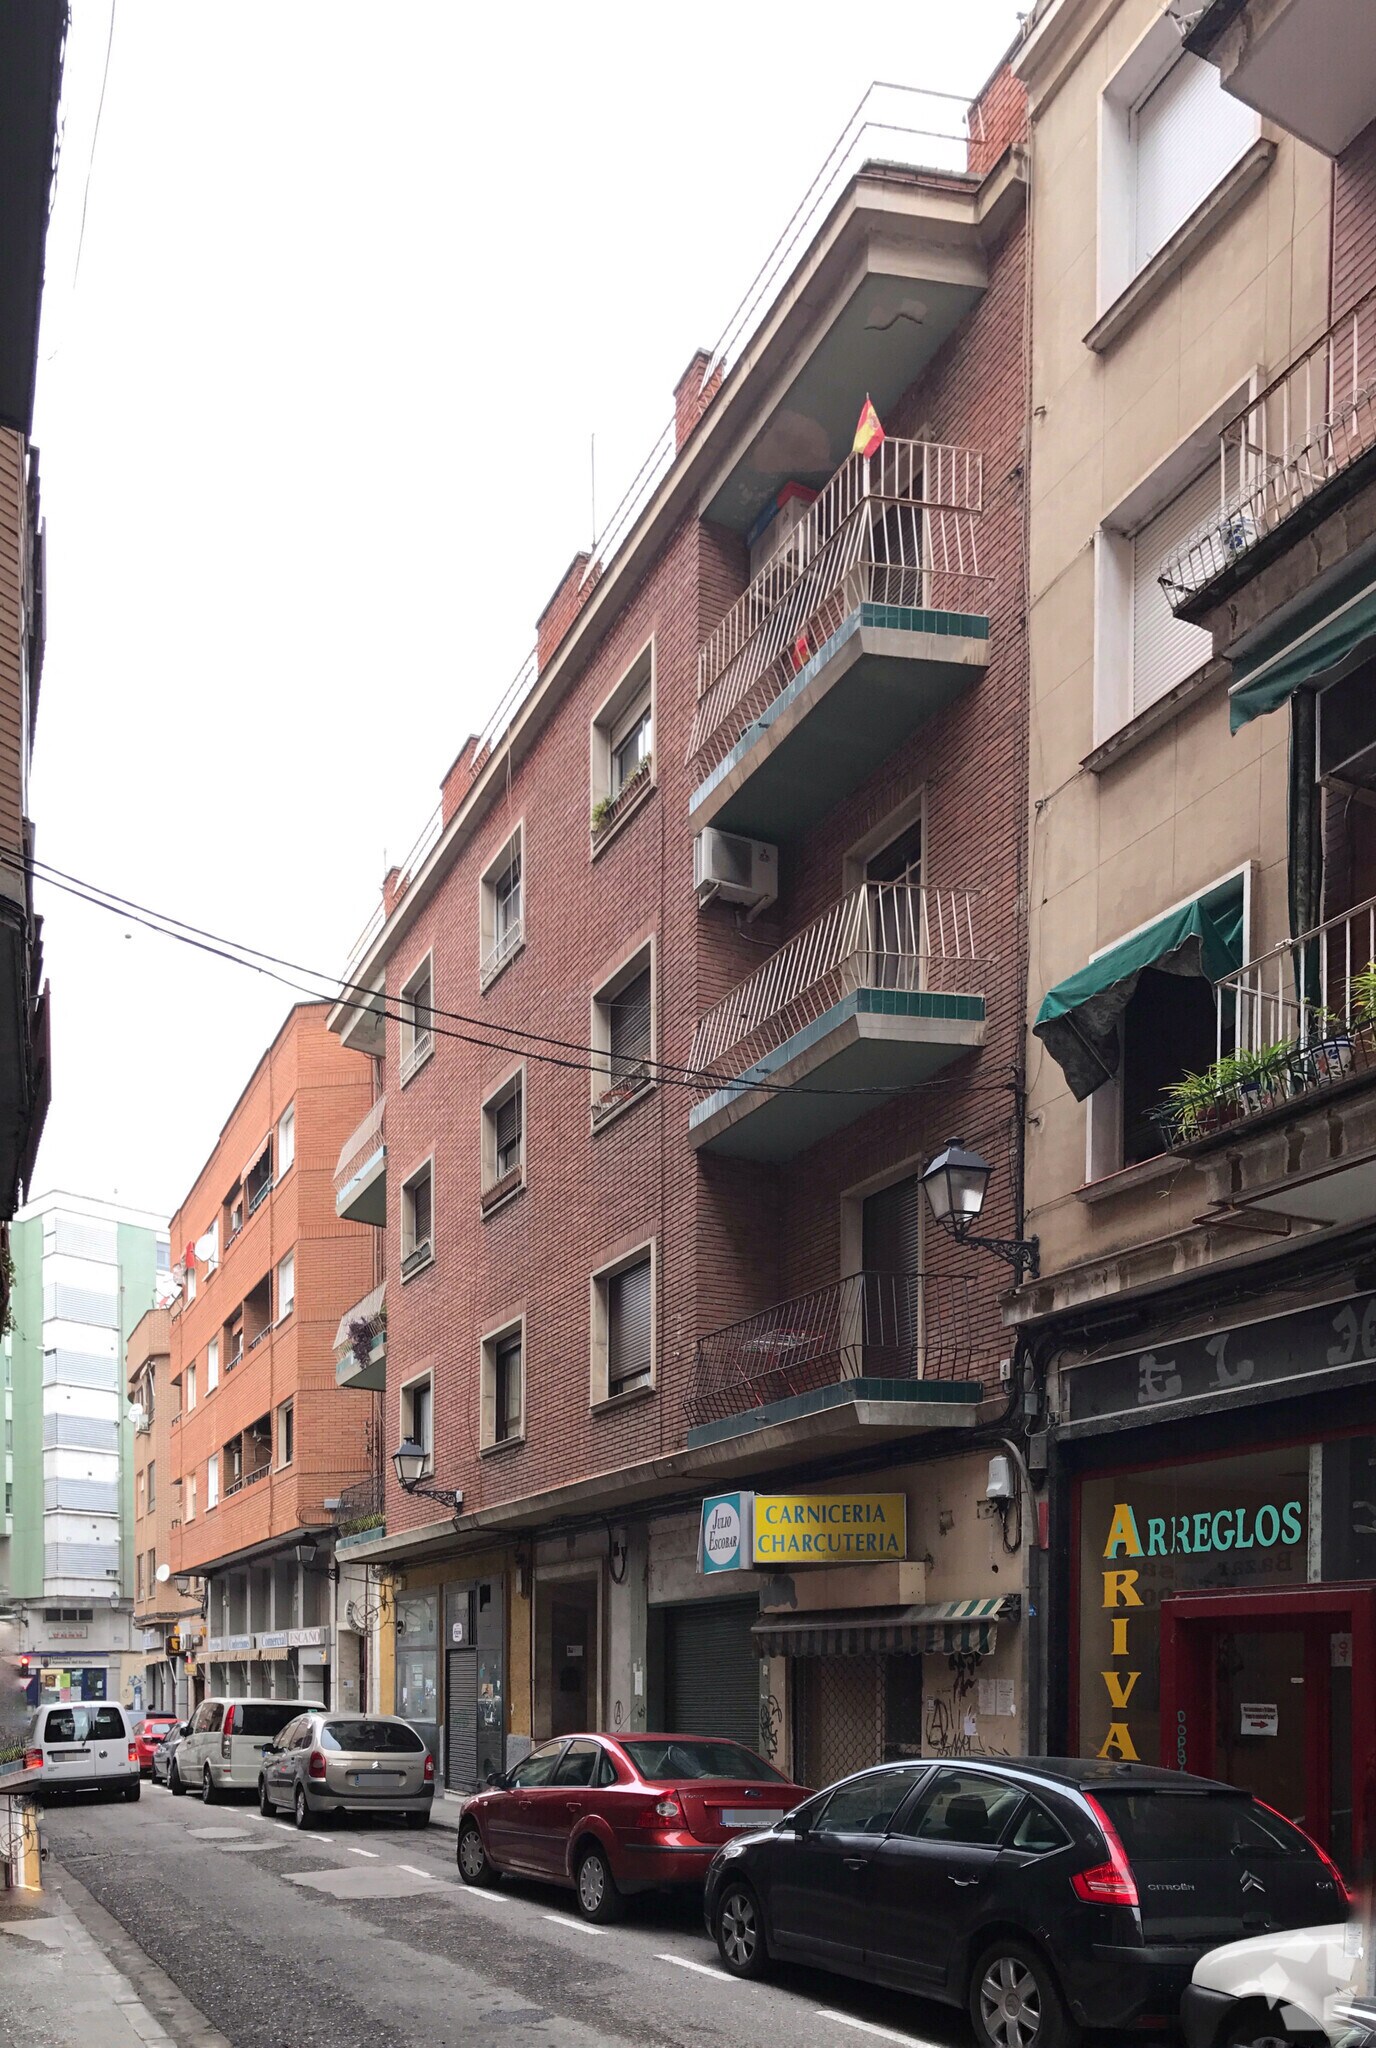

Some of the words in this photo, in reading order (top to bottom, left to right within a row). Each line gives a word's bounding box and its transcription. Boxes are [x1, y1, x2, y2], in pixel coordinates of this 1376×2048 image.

[712, 1509, 732, 1530] JULIO
[765, 1504, 886, 1524] CARNICERIA
[1104, 1501, 1302, 1559] ARREGLOS
[708, 1530, 738, 1552] ESCOBAR
[757, 1533, 900, 1553] CHARCUTERIA
[1147, 1883, 1195, 1891] CITROËN
